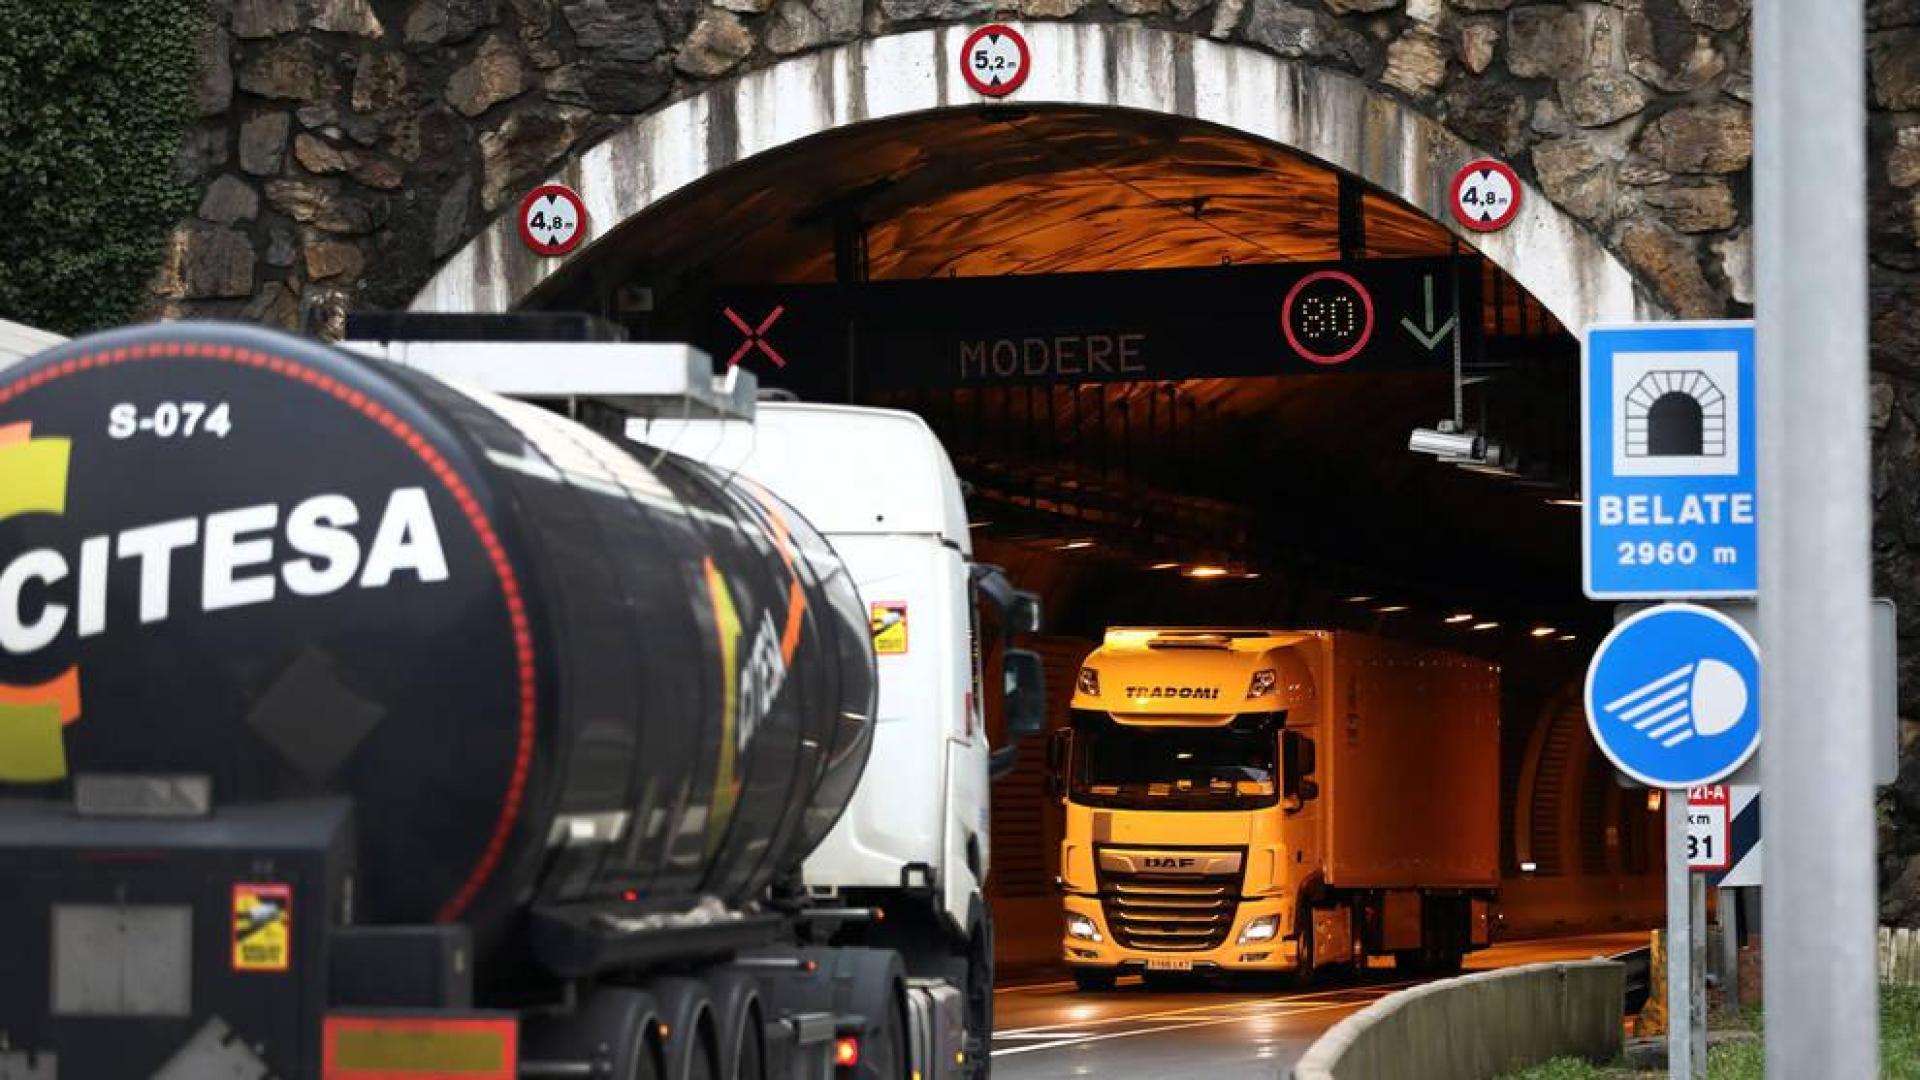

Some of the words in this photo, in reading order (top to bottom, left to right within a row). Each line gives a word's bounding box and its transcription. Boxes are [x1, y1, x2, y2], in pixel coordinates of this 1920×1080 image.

[1302, 296, 1354, 338] 80
[959, 334, 1147, 379] MODERE
[108, 403, 231, 439] S-074
[1599, 494, 1754, 525] BELATE
[1617, 540, 1697, 566] 2960
[1713, 546, 1737, 565] m
[0, 487, 449, 655] CITESA
[1126, 685, 1219, 699] TRADOMI
[1144, 857, 1195, 868] DAF
